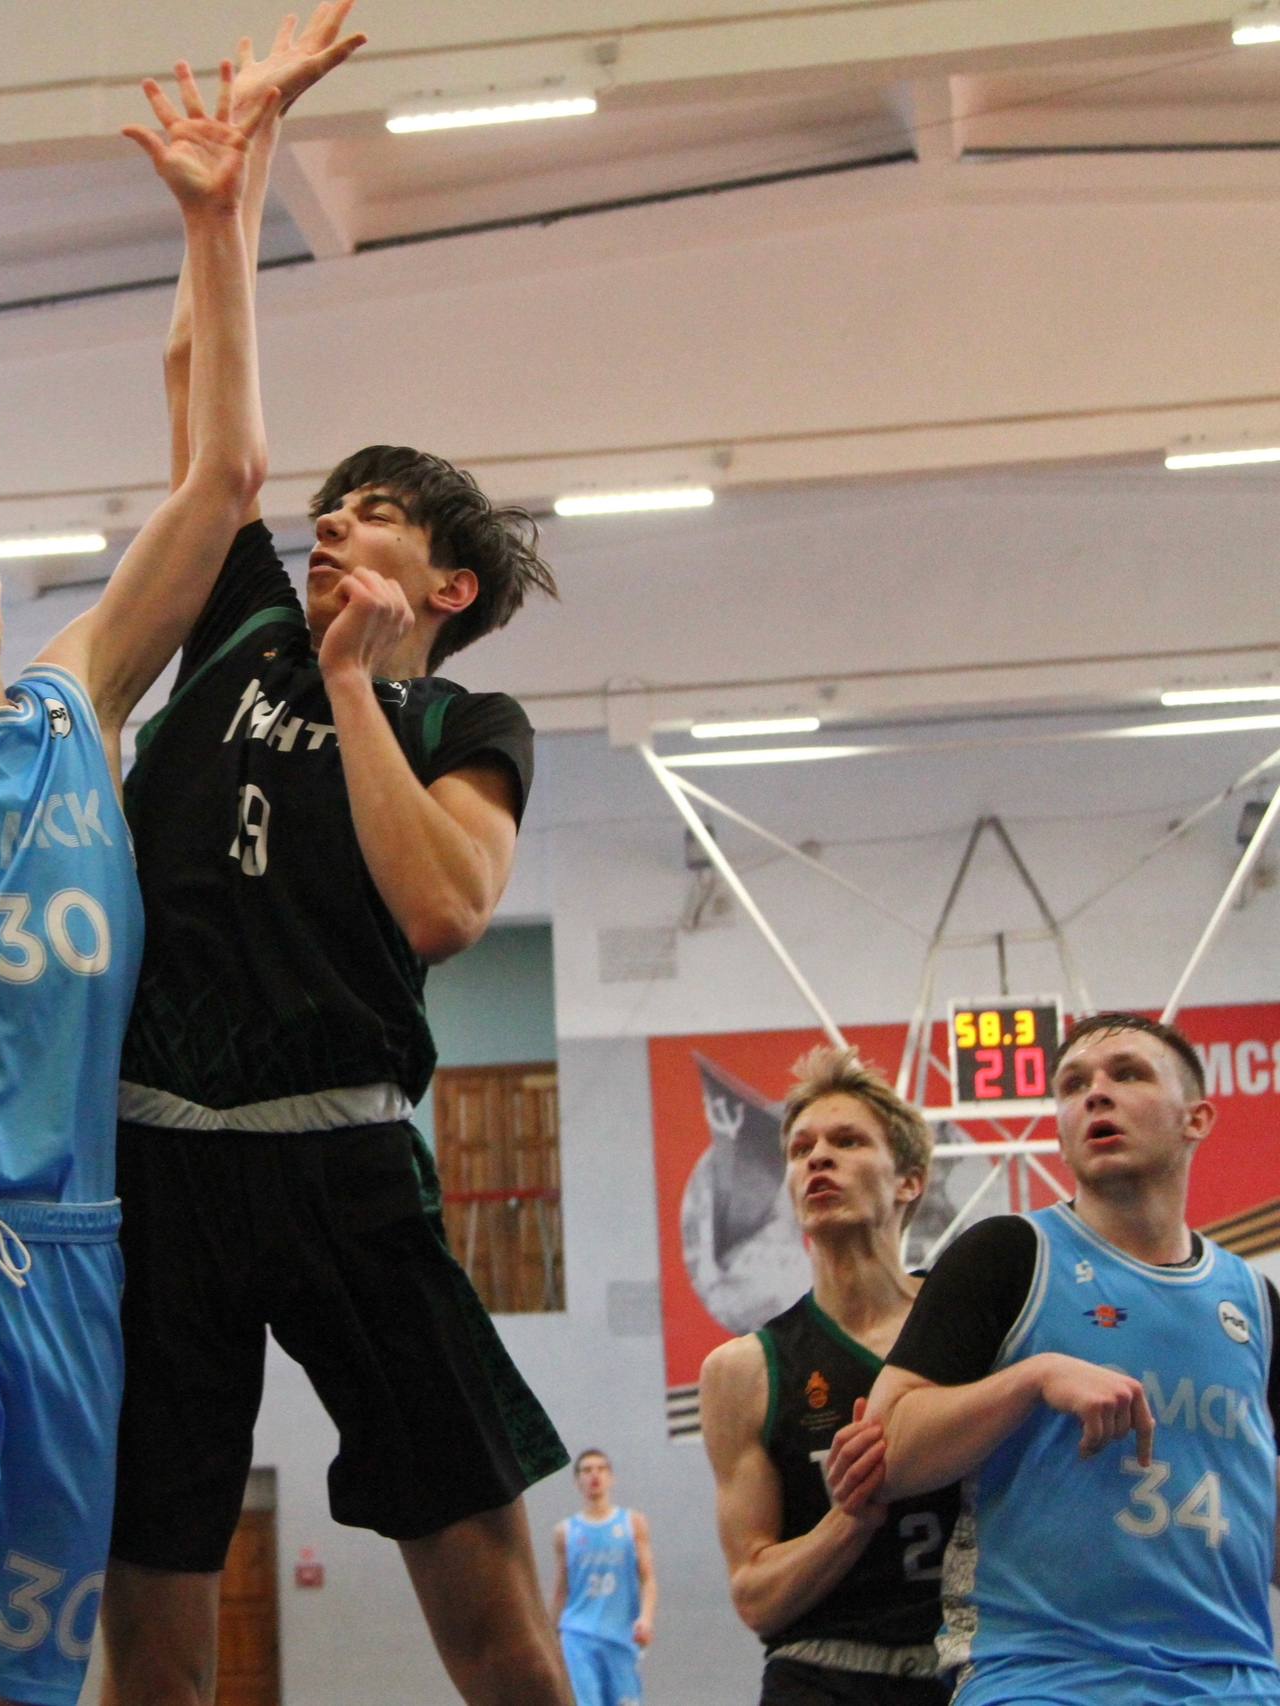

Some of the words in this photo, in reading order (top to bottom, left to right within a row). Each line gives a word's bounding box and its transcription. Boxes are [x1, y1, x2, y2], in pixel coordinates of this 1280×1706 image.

[228, 783, 270, 877] 9
[954, 1009, 1035, 1049] 58.3
[973, 1046, 1047, 1099] 20
[1193, 1040, 1280, 1097] МС
[1103, 1363, 1262, 1446] МСК
[1113, 1457, 1230, 1548] 34
